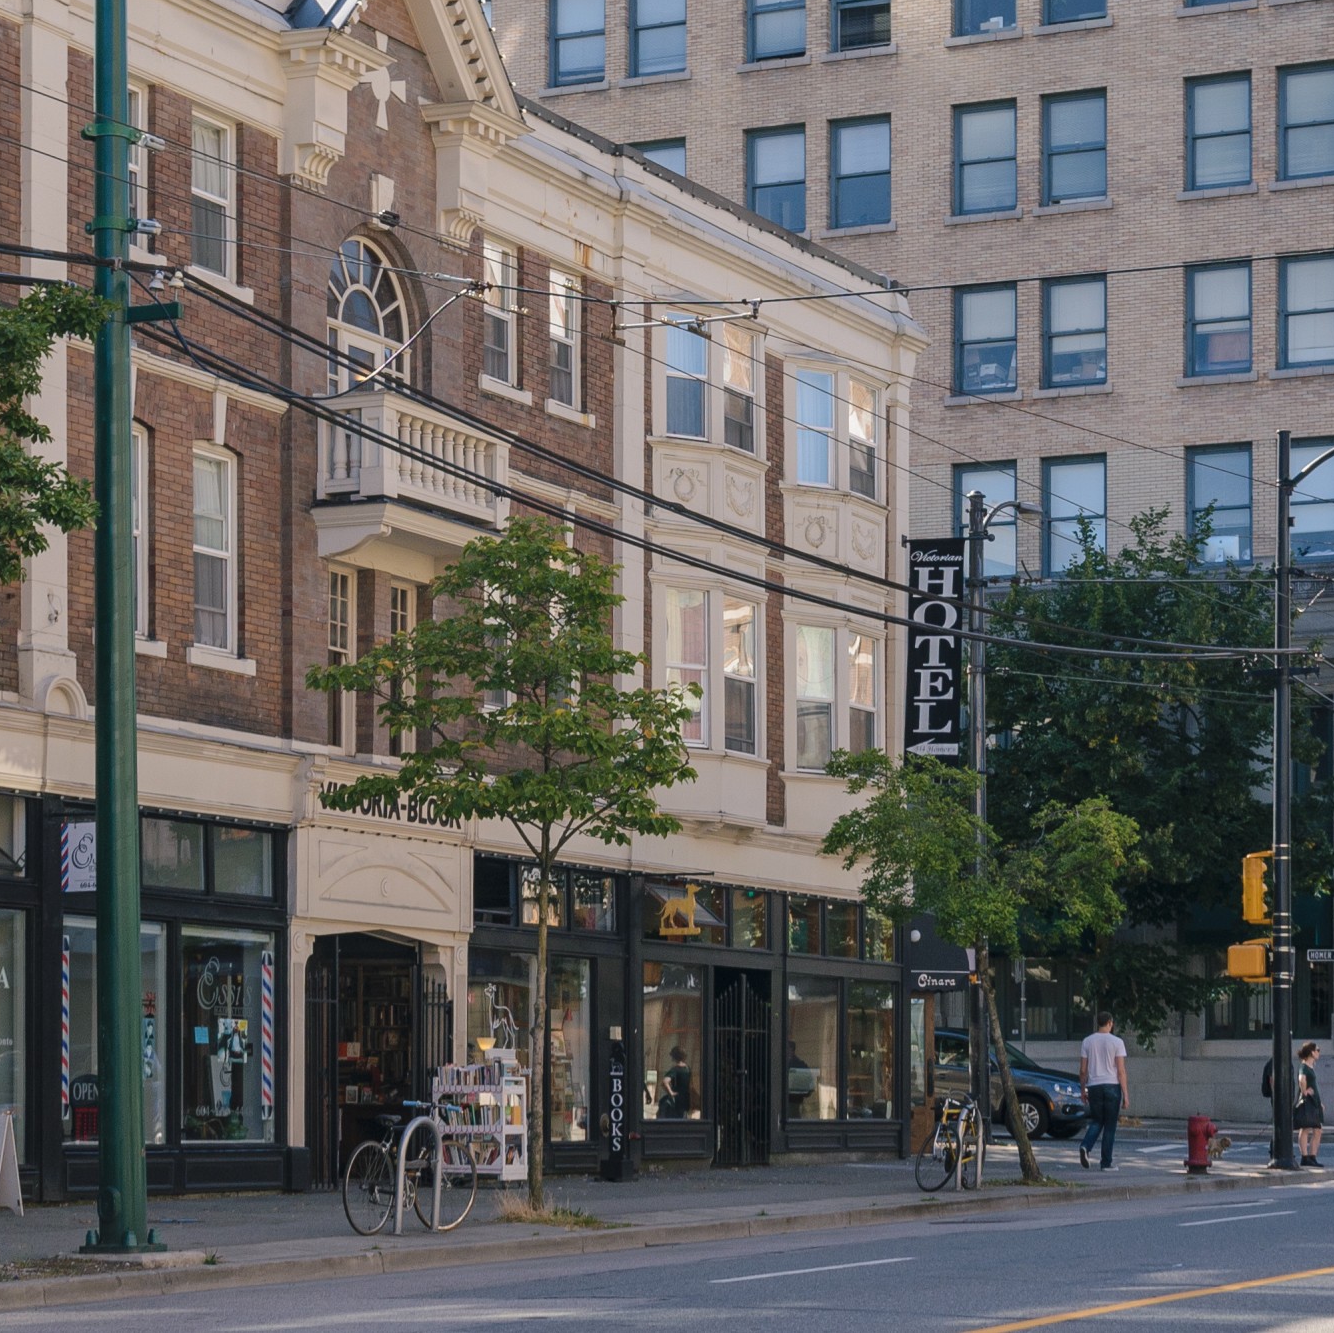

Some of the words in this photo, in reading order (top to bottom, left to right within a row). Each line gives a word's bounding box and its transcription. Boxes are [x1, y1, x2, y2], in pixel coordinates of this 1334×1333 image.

[910, 549, 964, 563] Victorian
[912, 566, 959, 734] HOTEL
[1310, 951, 1332, 960] HOMER
[610, 1078, 624, 1152] BOOKS
